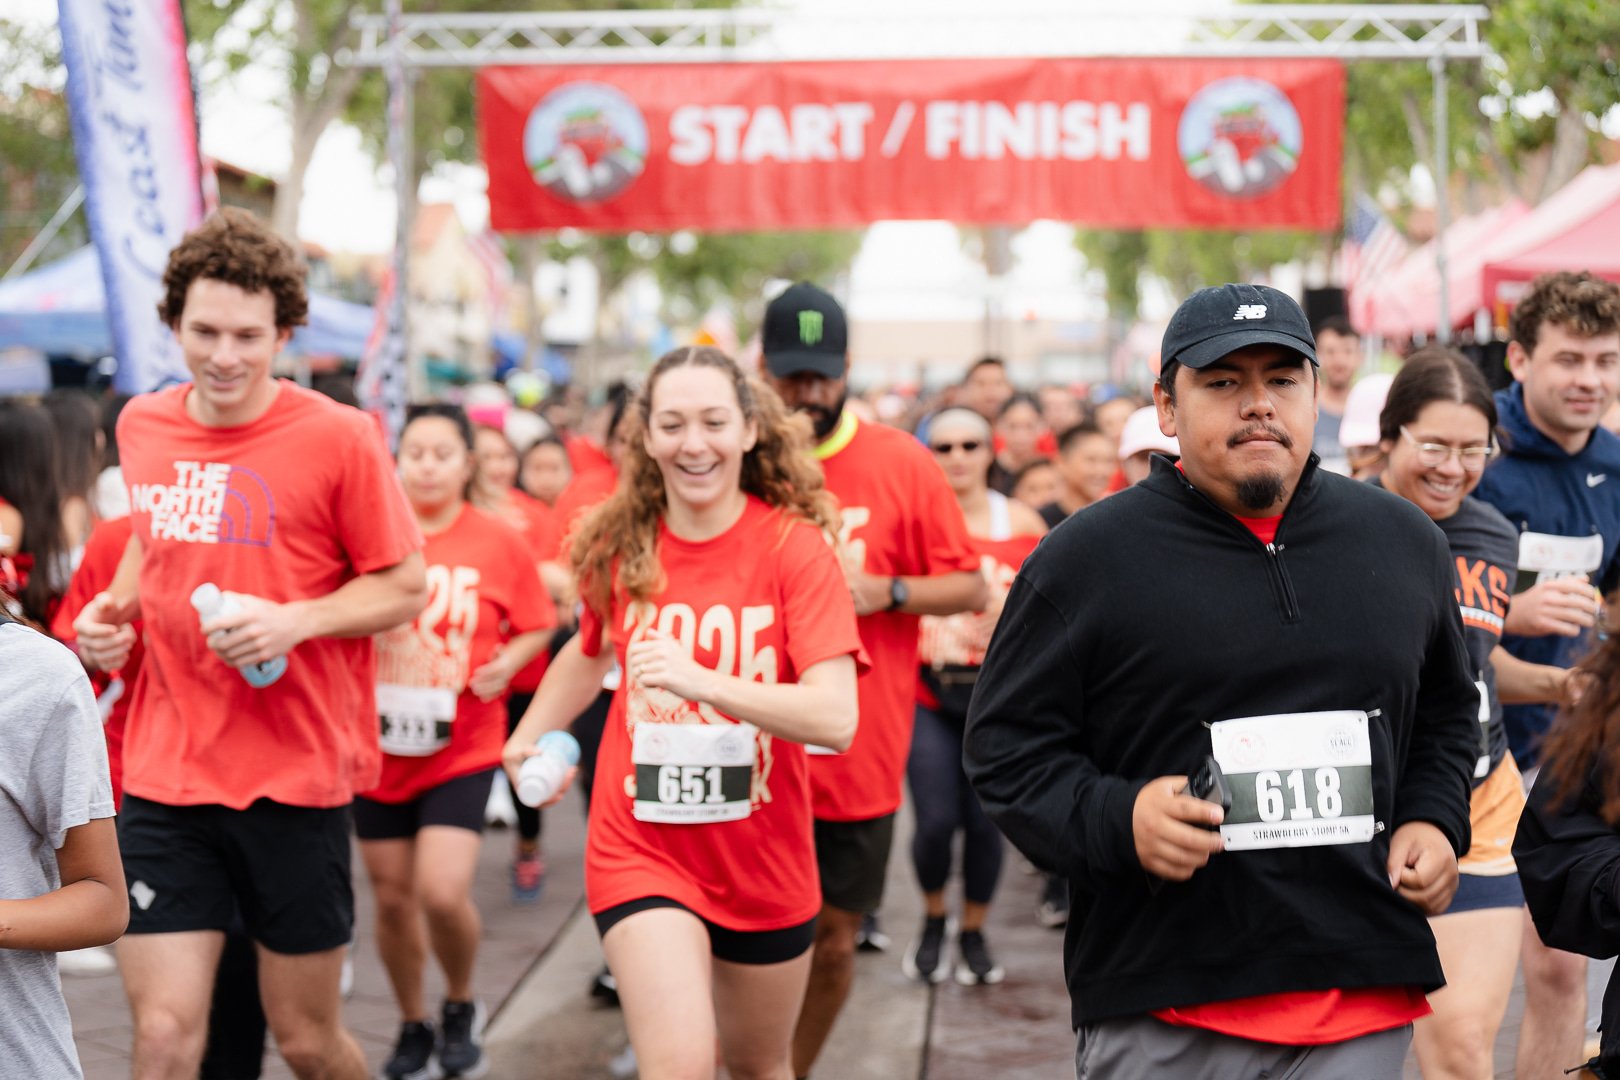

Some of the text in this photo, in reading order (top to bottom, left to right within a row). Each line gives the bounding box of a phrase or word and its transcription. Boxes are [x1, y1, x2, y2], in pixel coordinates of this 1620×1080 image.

[668, 99, 1150, 165] START / FINISH
[1233, 304, 1267, 320] NB
[173, 461, 231, 488] THE
[132, 484, 226, 515] NORTH
[151, 511, 221, 543] FACE
[1454, 556, 1510, 618] KS
[658, 765, 726, 804] 651
[1256, 766, 1342, 822] 618
[1253, 827, 1309, 840] STRAWBERRY
